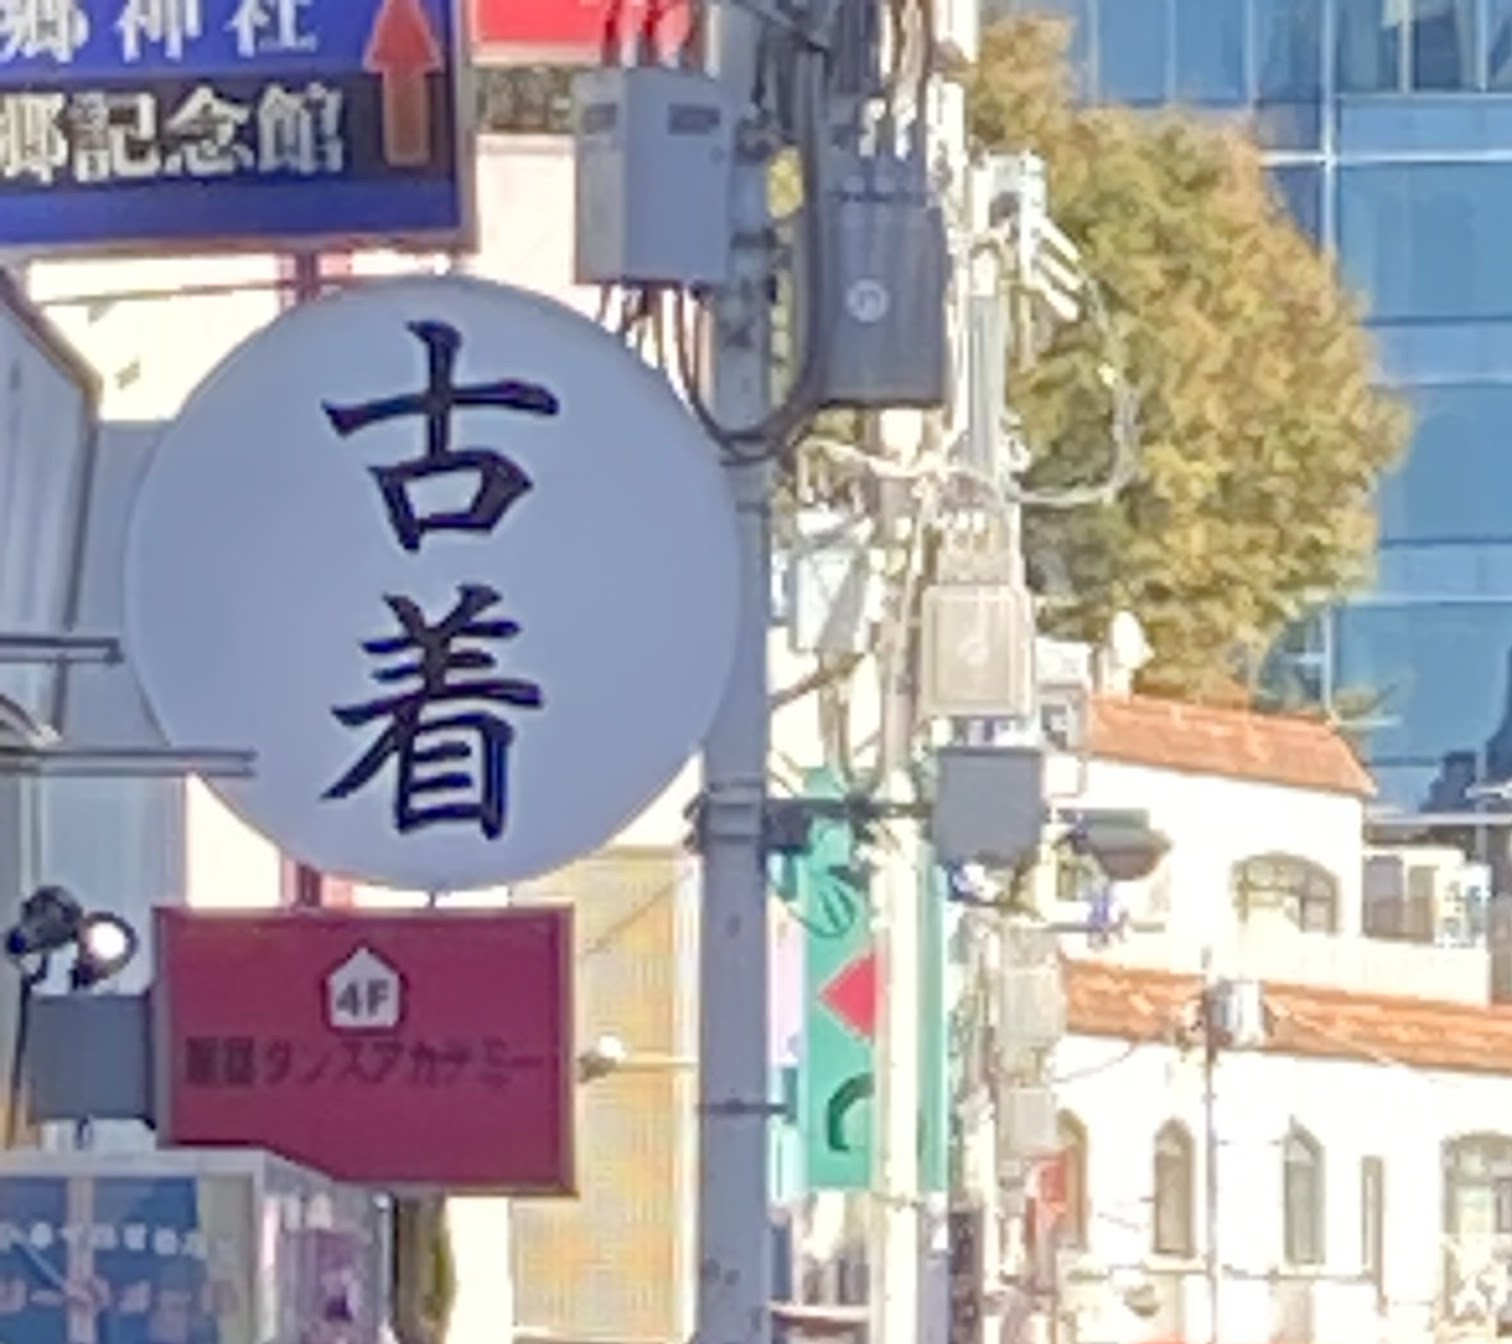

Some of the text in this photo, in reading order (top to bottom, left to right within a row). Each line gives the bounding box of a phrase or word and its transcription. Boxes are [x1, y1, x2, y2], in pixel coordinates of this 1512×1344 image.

[0, 82, 345, 182] 郷記念館
[319, 318, 561, 842] 古着
[335, 978, 390, 1018] 4F
